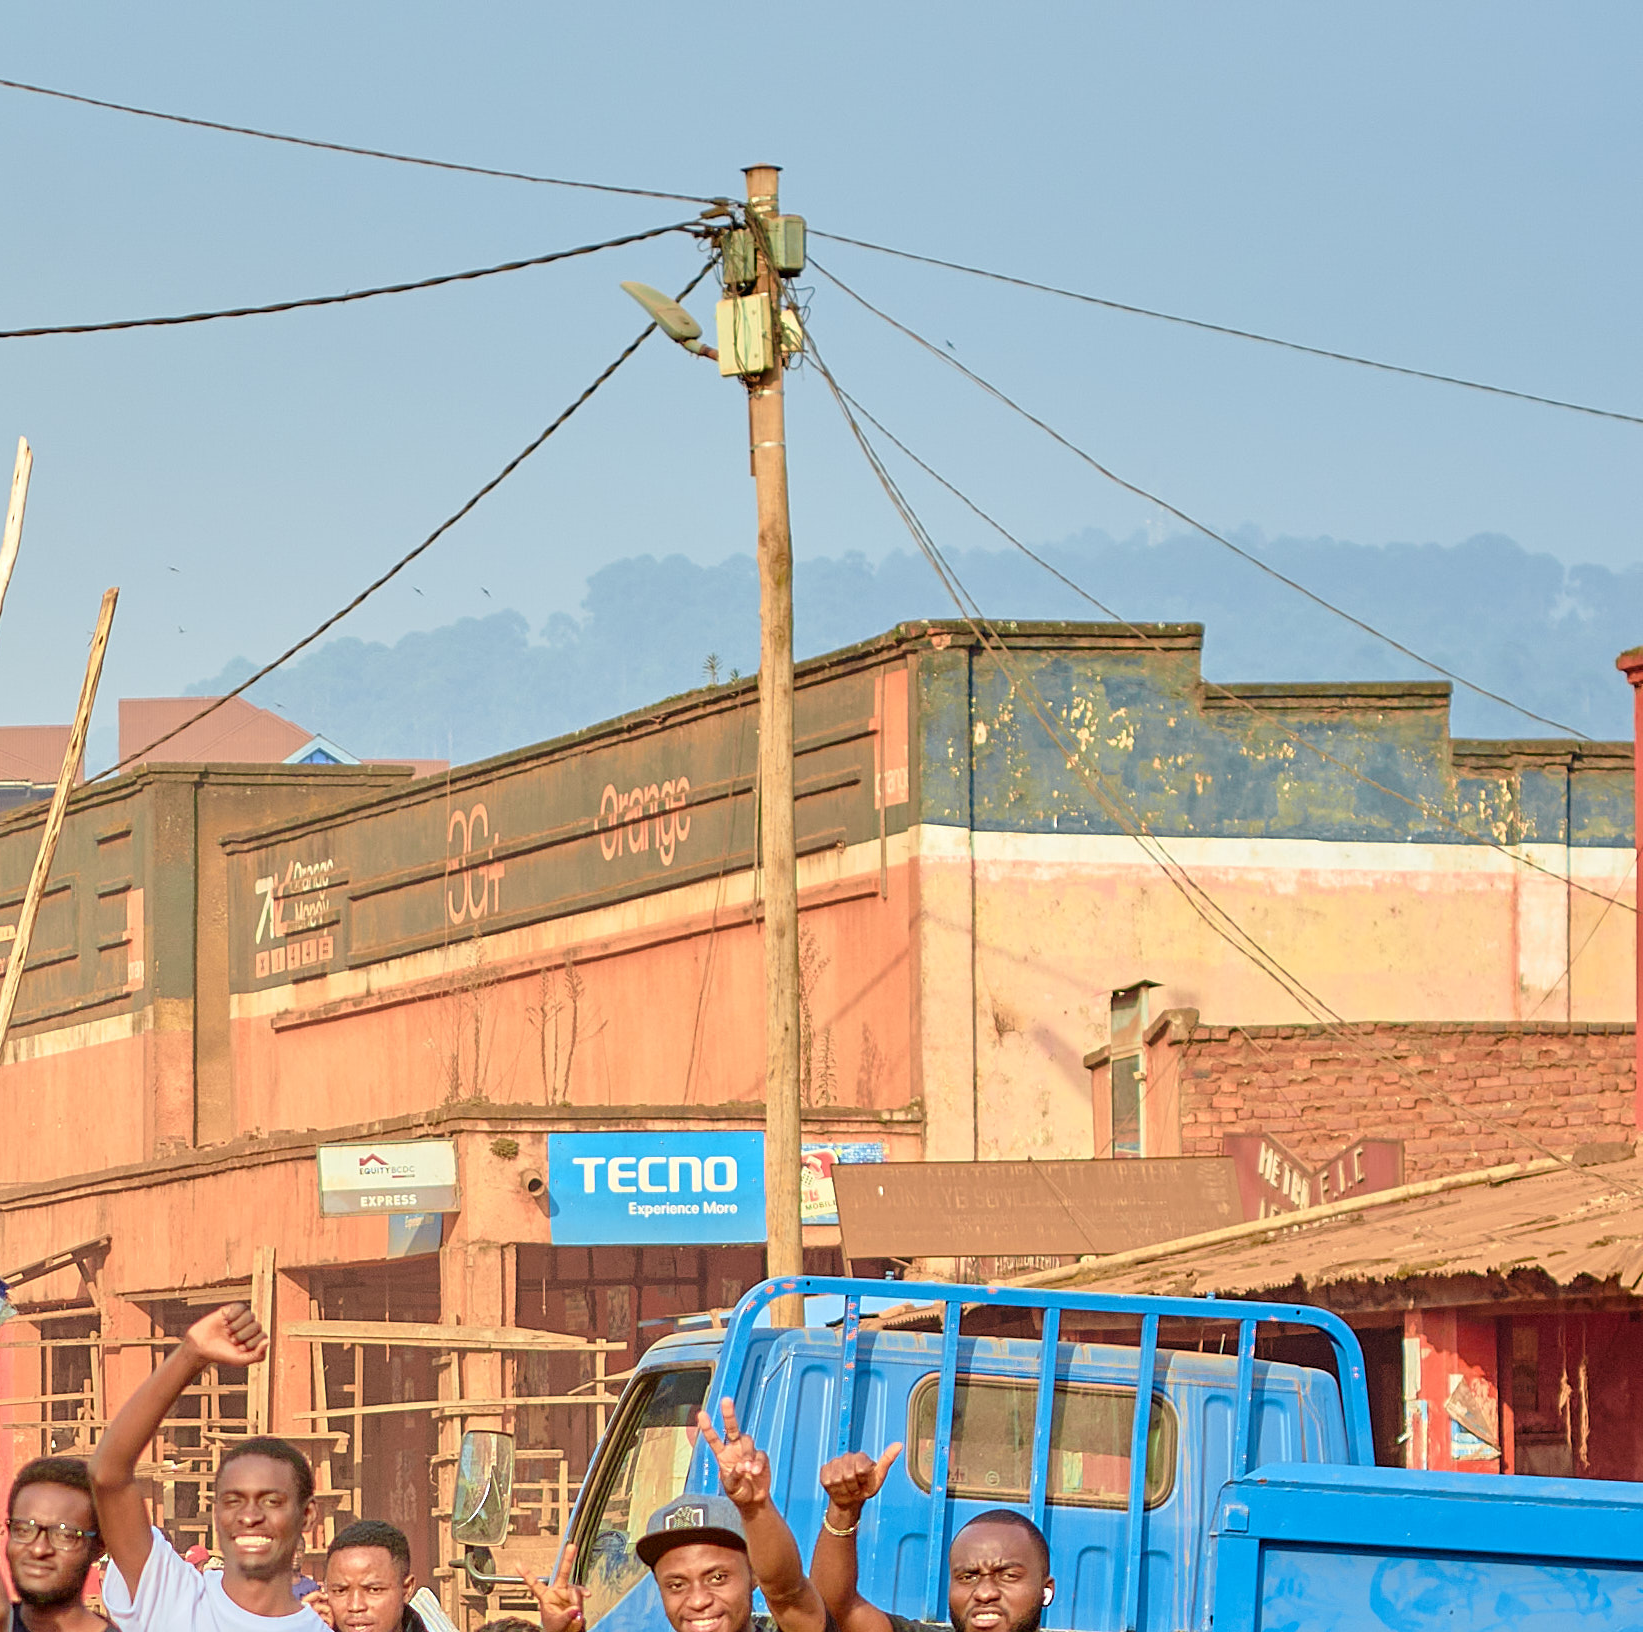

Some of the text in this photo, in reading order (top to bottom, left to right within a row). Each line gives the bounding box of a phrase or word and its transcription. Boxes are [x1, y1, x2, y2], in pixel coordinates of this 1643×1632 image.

[597, 779, 691, 866] Orange
[573, 1156, 738, 1194] TECNO
[360, 1194, 417, 1207] EXPRESS
[628, 1200, 738, 1217] Experience More
